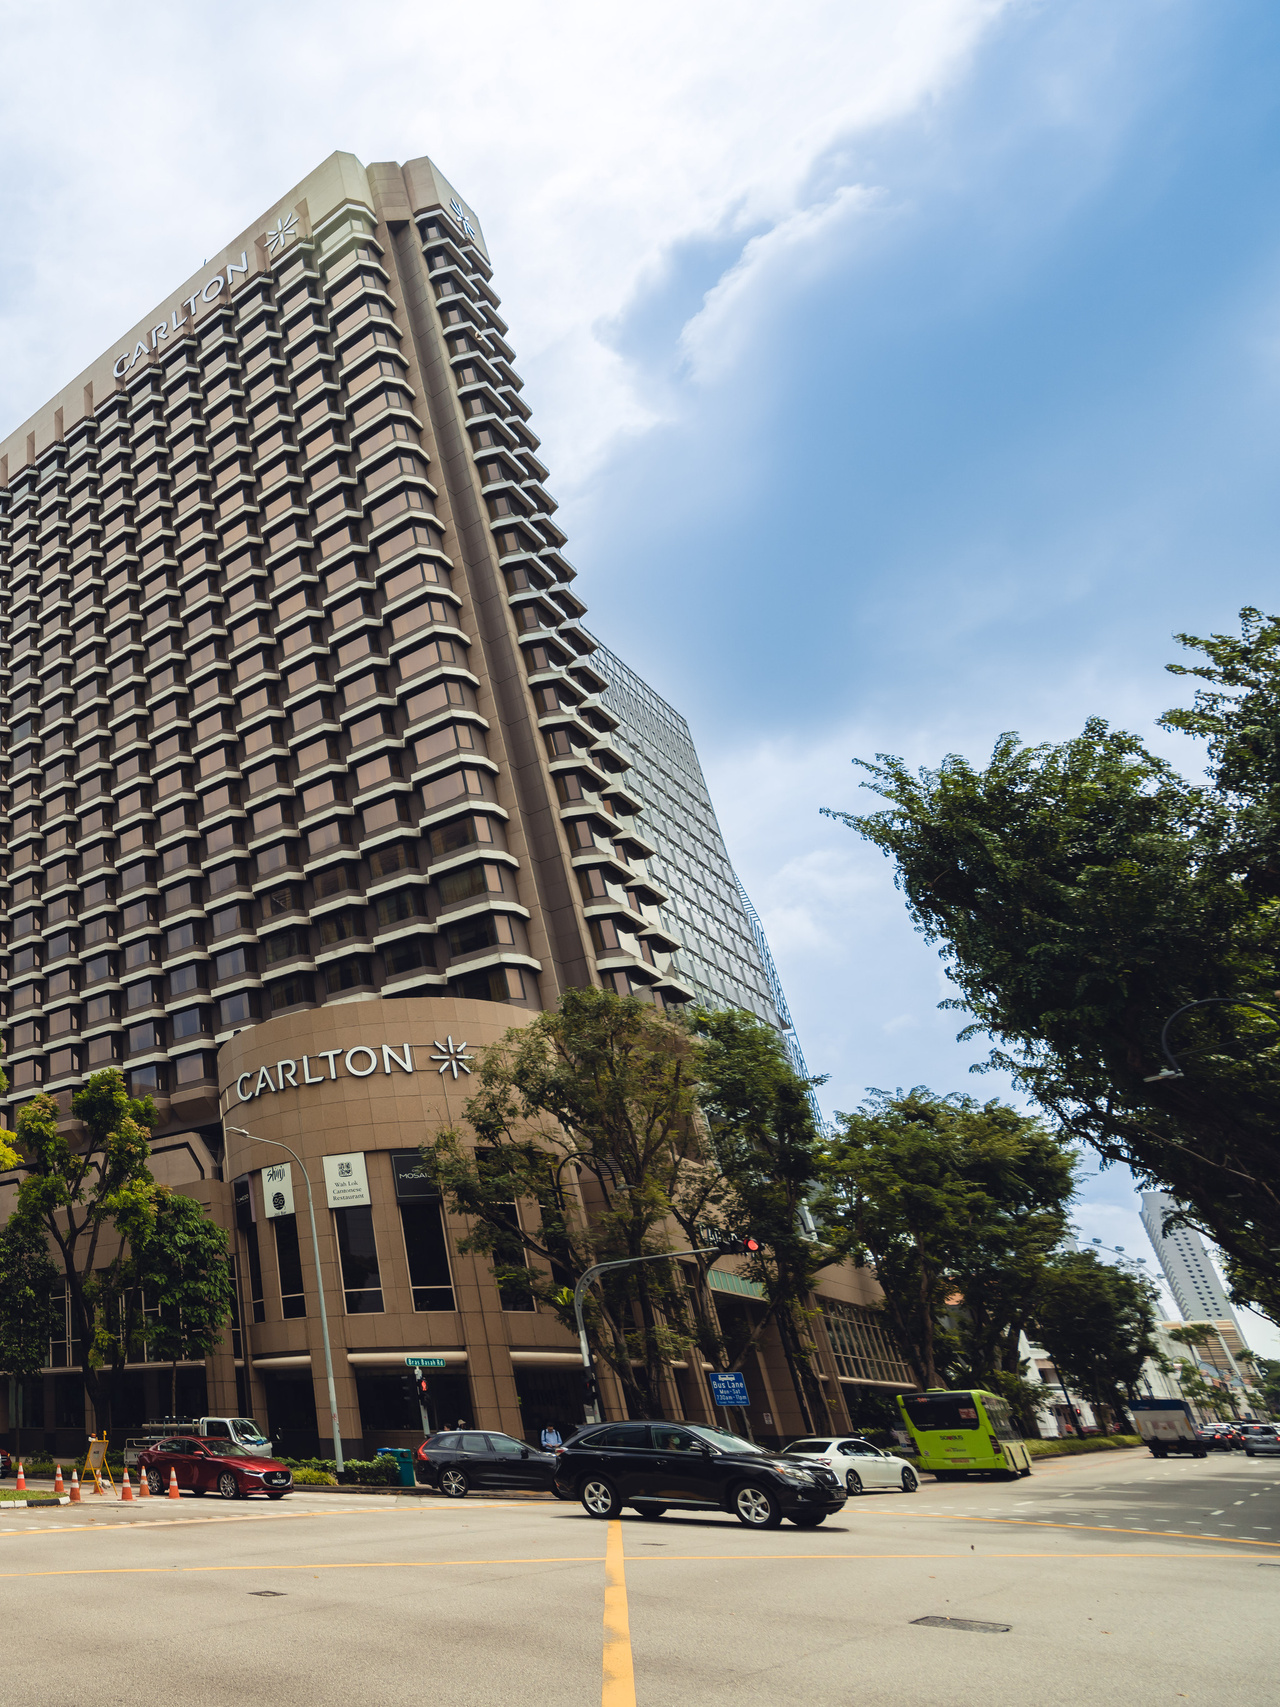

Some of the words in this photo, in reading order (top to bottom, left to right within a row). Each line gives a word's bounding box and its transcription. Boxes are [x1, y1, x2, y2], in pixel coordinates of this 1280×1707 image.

[113, 251, 249, 378] CARLTON
[236, 1043, 413, 1101] CARLTON
[332, 1187, 362, 1195] Cantonese
[332, 1193, 364, 1201] Restaurant
[713, 1381, 726, 1389] Bus
